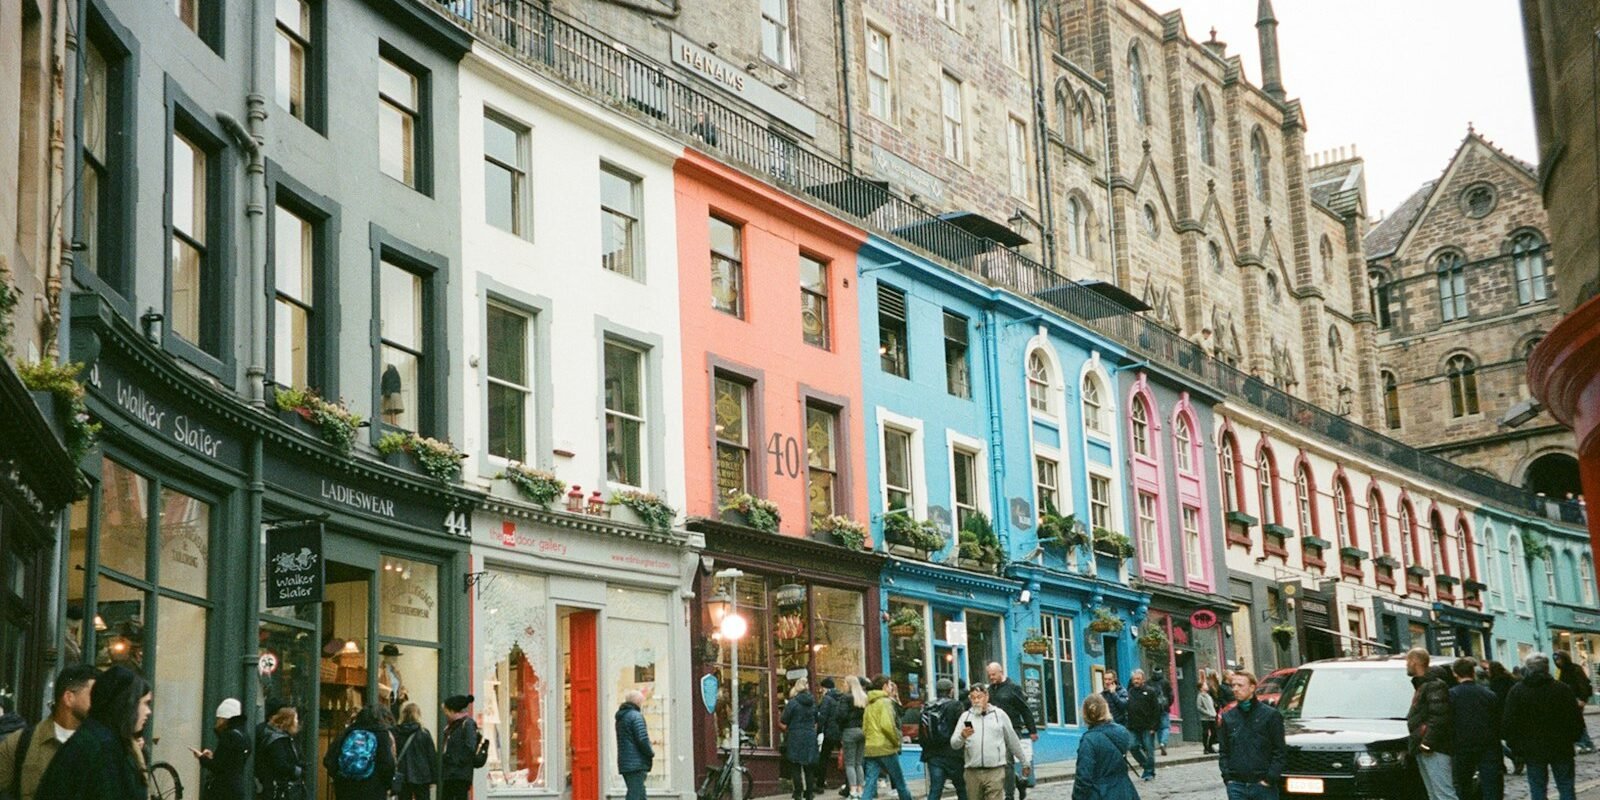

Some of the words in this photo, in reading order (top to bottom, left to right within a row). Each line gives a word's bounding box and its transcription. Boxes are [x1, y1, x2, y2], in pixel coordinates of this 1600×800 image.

[681, 44, 744, 92] HANAMS
[117, 379, 165, 430] Walker
[174, 415, 222, 459] Slater
[767, 432, 800, 479] 40
[321, 479, 395, 518] LADIESWEAR
[517, 534, 535, 547] door
[539, 538, 567, 555] gallery
[279, 586, 313, 599] Slater
